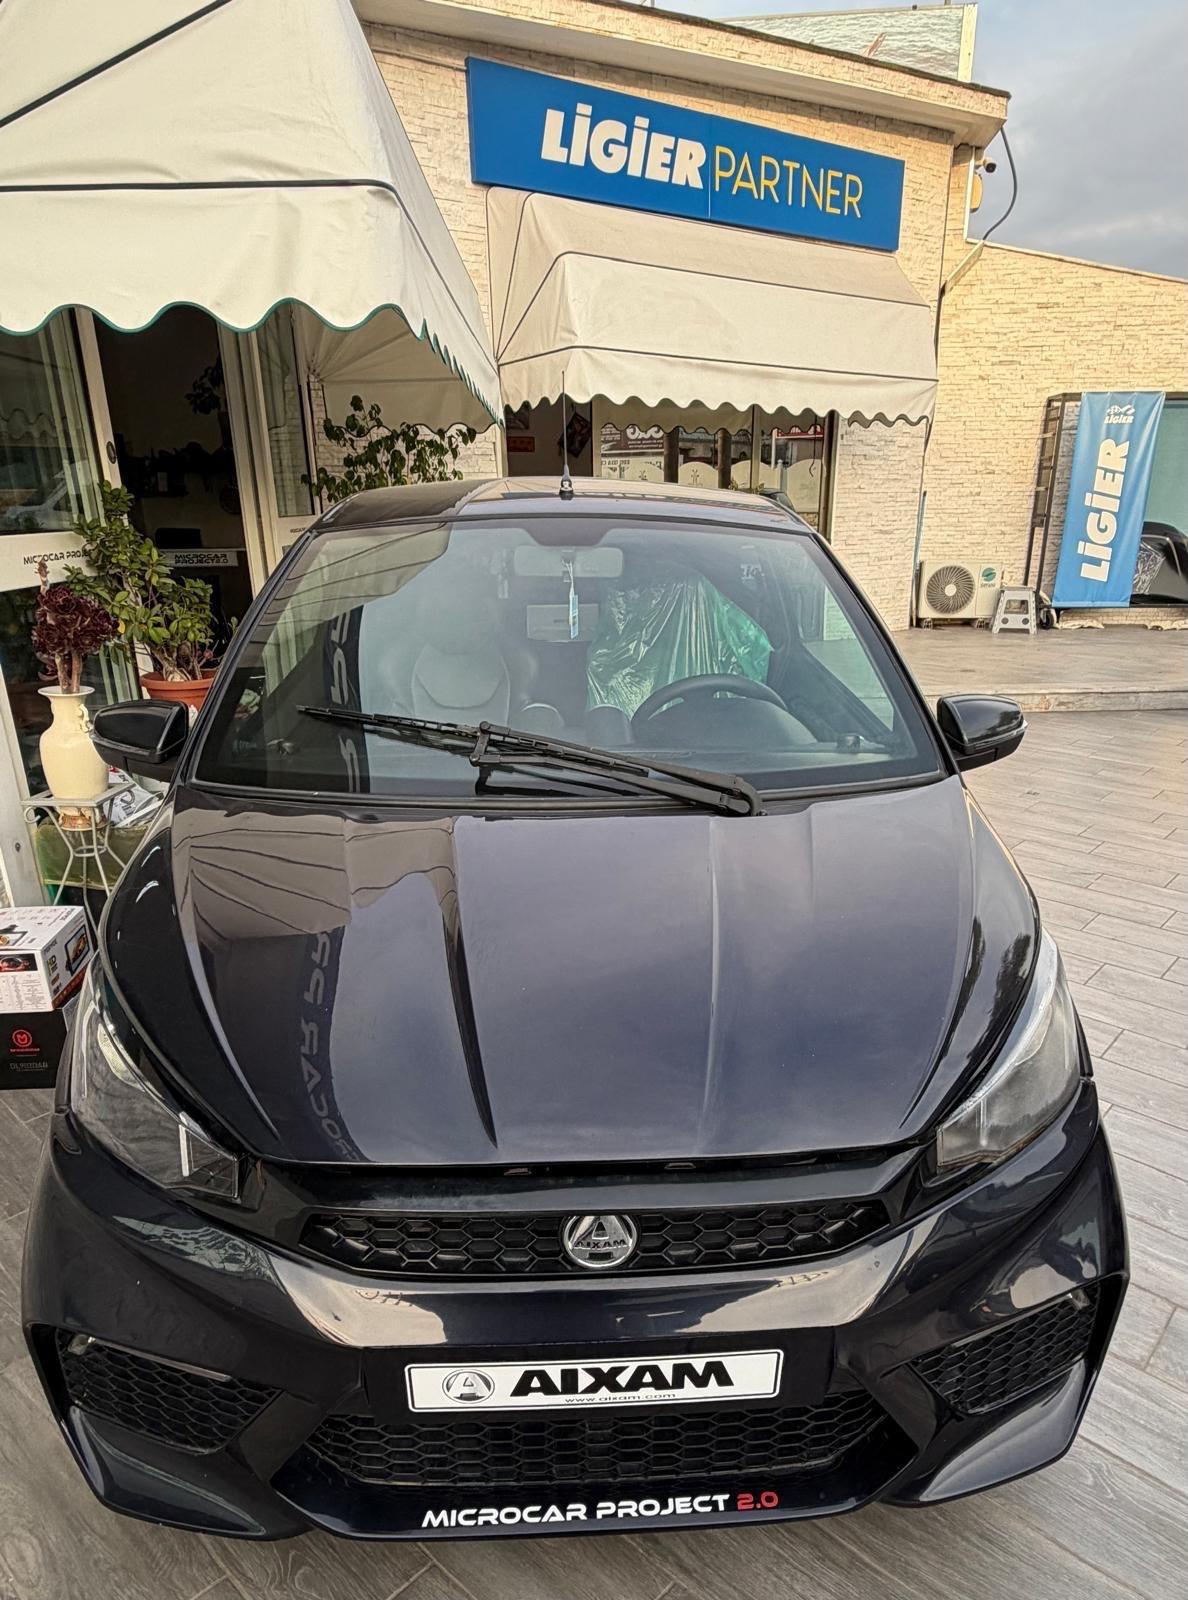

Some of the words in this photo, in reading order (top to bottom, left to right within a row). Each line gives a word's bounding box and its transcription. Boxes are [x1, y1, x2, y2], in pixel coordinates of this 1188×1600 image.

[715, 145, 863, 219] PARTNER
[574, 1239, 628, 1249] AIXAM
[509, 1360, 735, 1398] AIXAM
[564, 1393, 677, 1404] www.aixam.com
[421, 1504, 588, 1528] MICROCAR
[596, 1493, 731, 1518] PROJECT
[736, 1491, 780, 1512] 2.0
